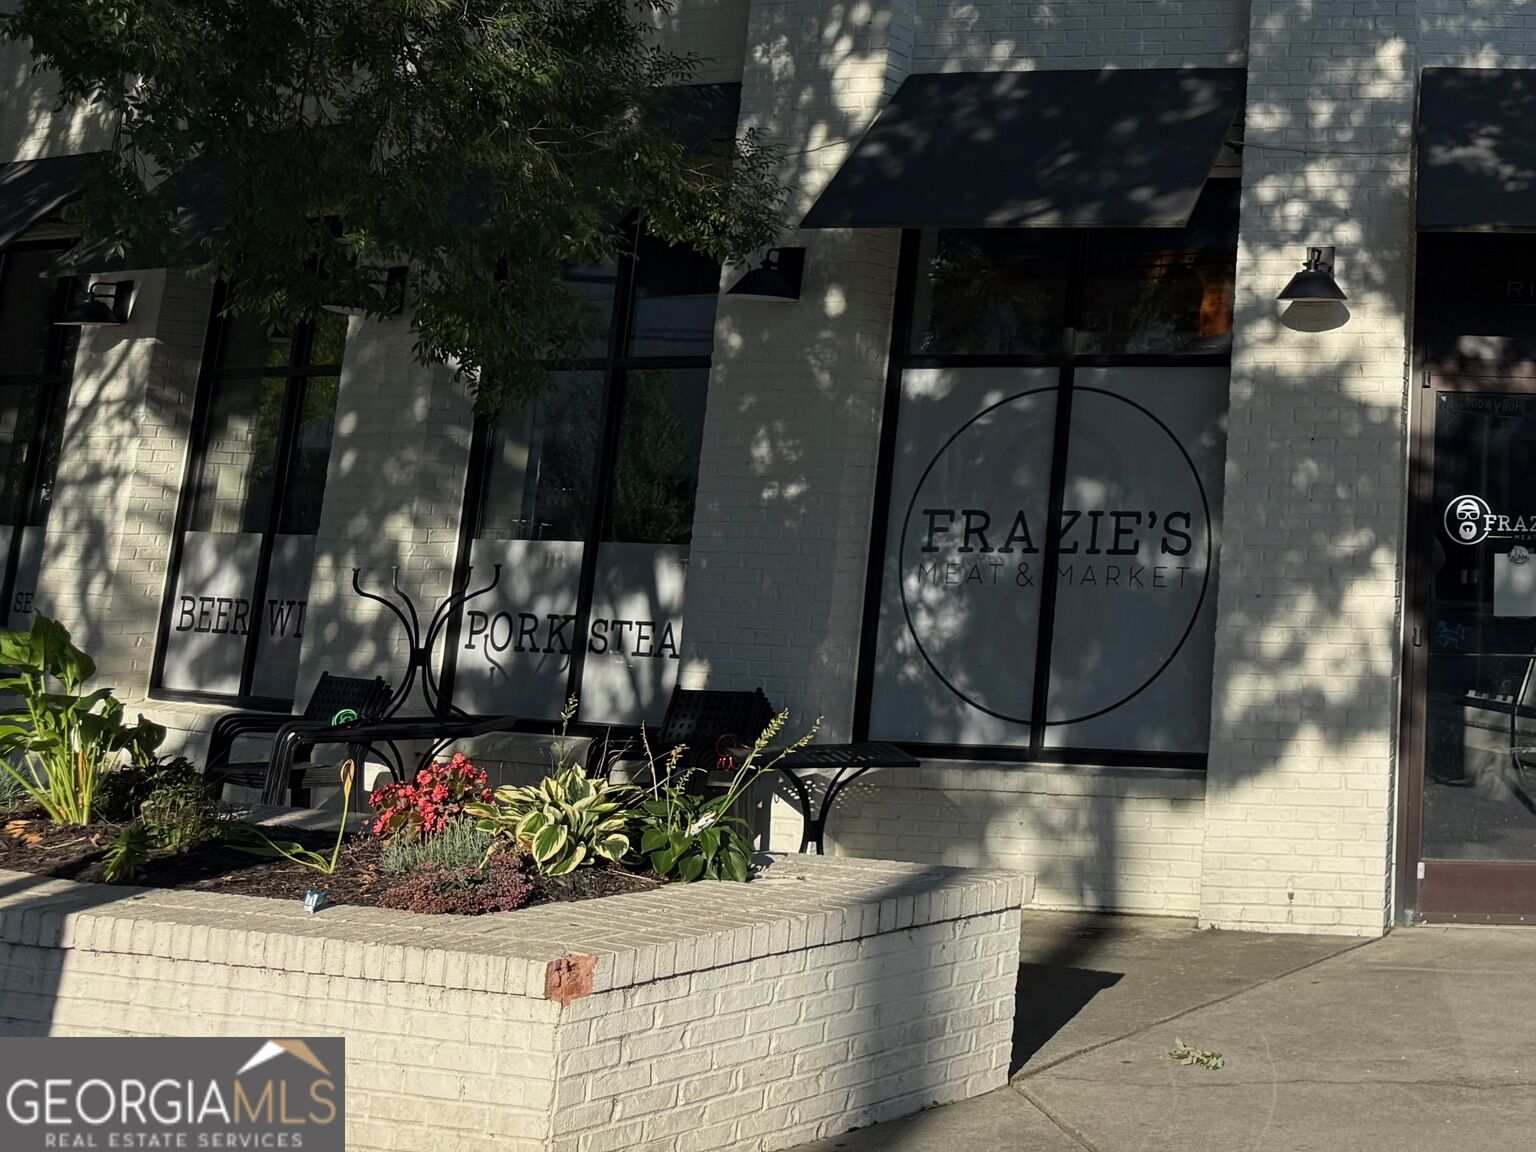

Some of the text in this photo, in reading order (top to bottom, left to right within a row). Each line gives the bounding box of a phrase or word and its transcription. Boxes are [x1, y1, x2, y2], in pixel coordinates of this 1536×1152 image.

[921, 509, 1192, 556] FRAZIE'S
[918, 562, 1191, 588] MEAT & MARKET
[14, 592, 34, 613] SE
[176, 595, 307, 638] BEER WI
[464, 610, 680, 659] PORK STEA
